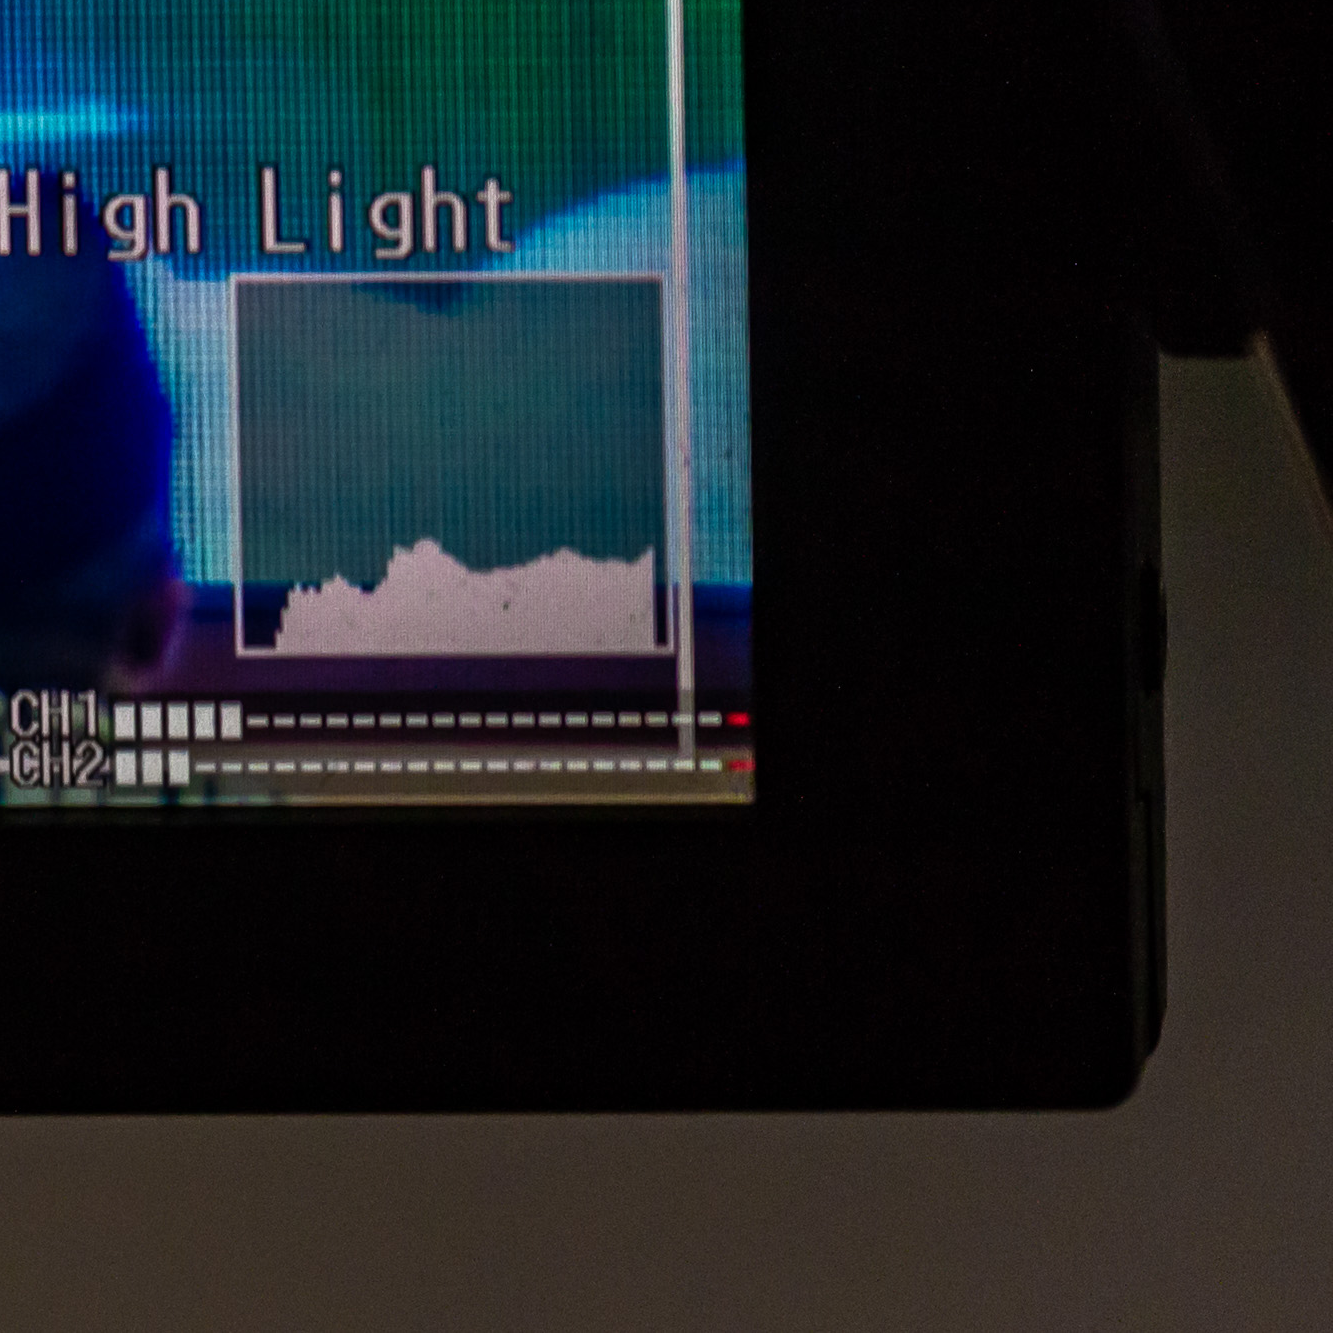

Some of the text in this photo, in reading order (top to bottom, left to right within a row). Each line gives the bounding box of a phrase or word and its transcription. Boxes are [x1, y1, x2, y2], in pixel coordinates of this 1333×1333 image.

[260, 164, 515, 260] Light
[9, 690, 101, 738] CH1
[9, 740, 107, 790] CH2
